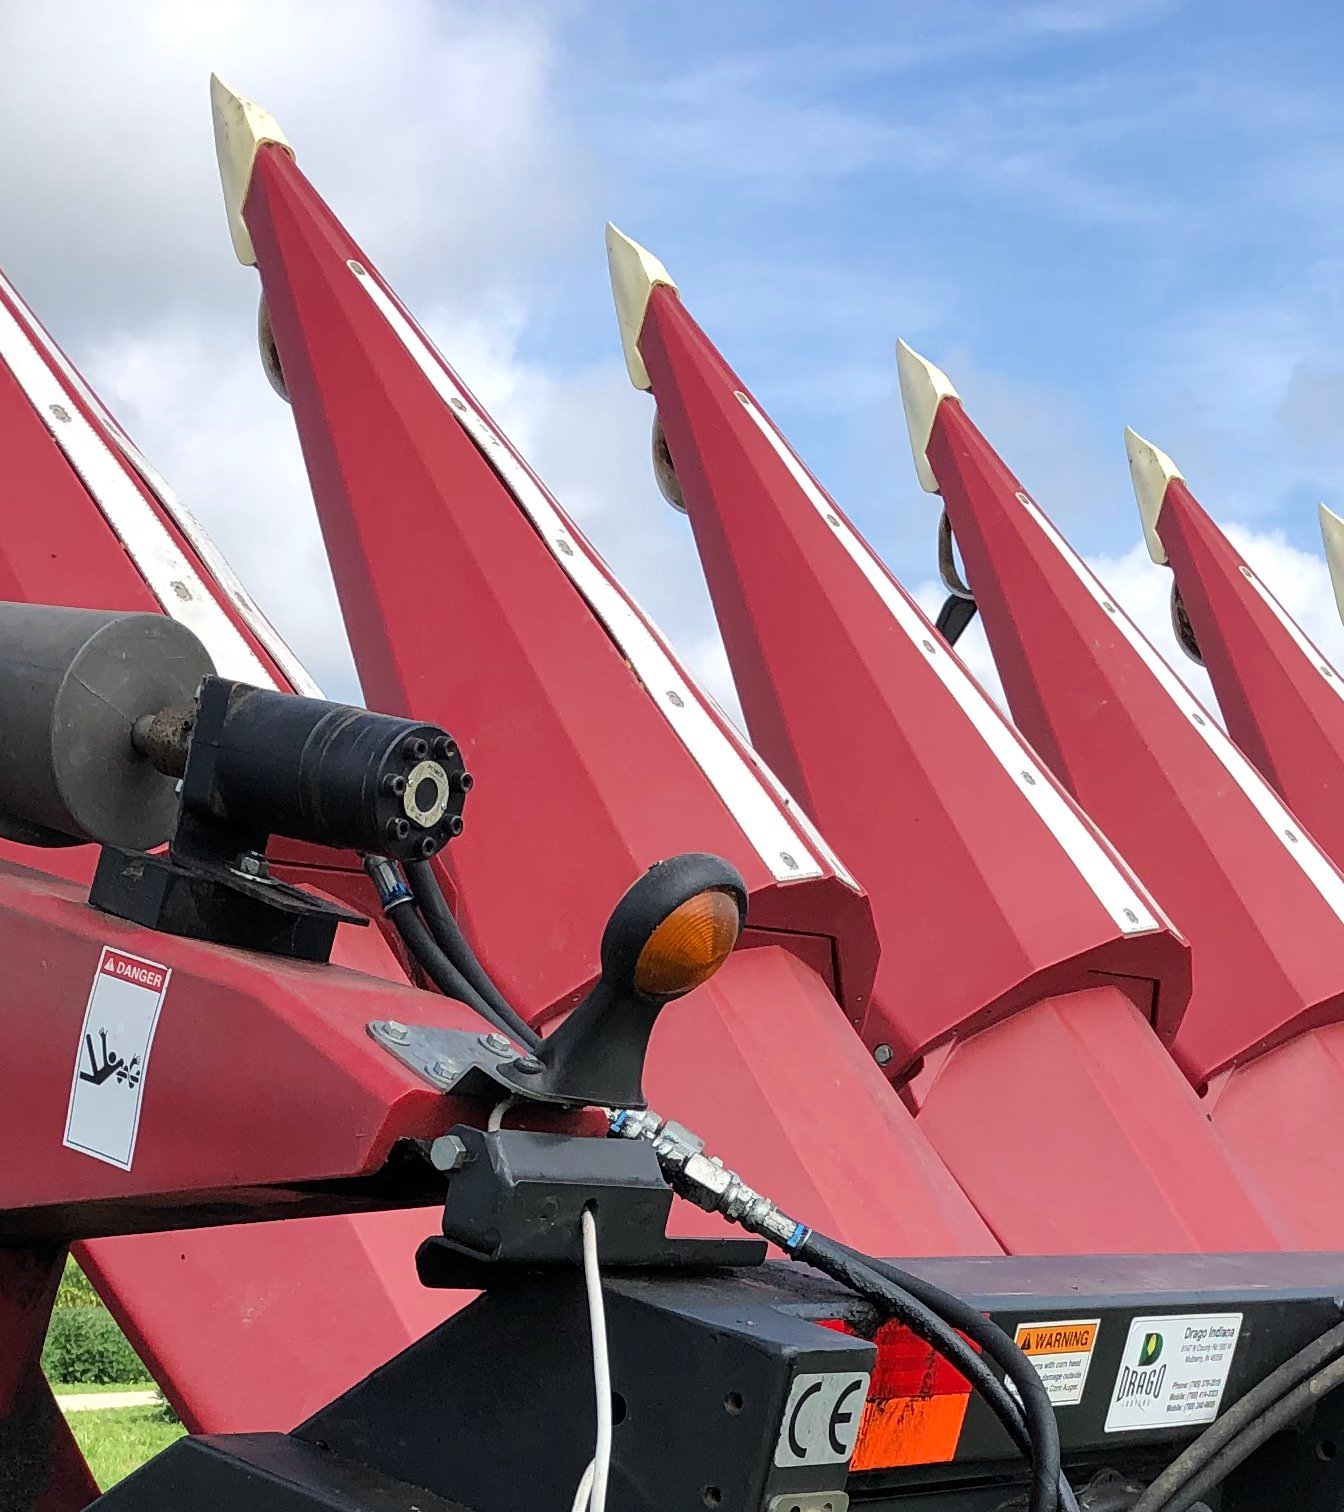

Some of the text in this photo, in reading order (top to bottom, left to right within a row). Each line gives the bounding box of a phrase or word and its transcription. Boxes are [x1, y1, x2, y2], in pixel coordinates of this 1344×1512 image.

[117, 962, 163, 988] DANGER
[1035, 1330, 1090, 1350] WARNING
[1184, 1325, 1235, 1341] Drago Indiana
[1116, 1363, 1167, 1403] DRAGO
